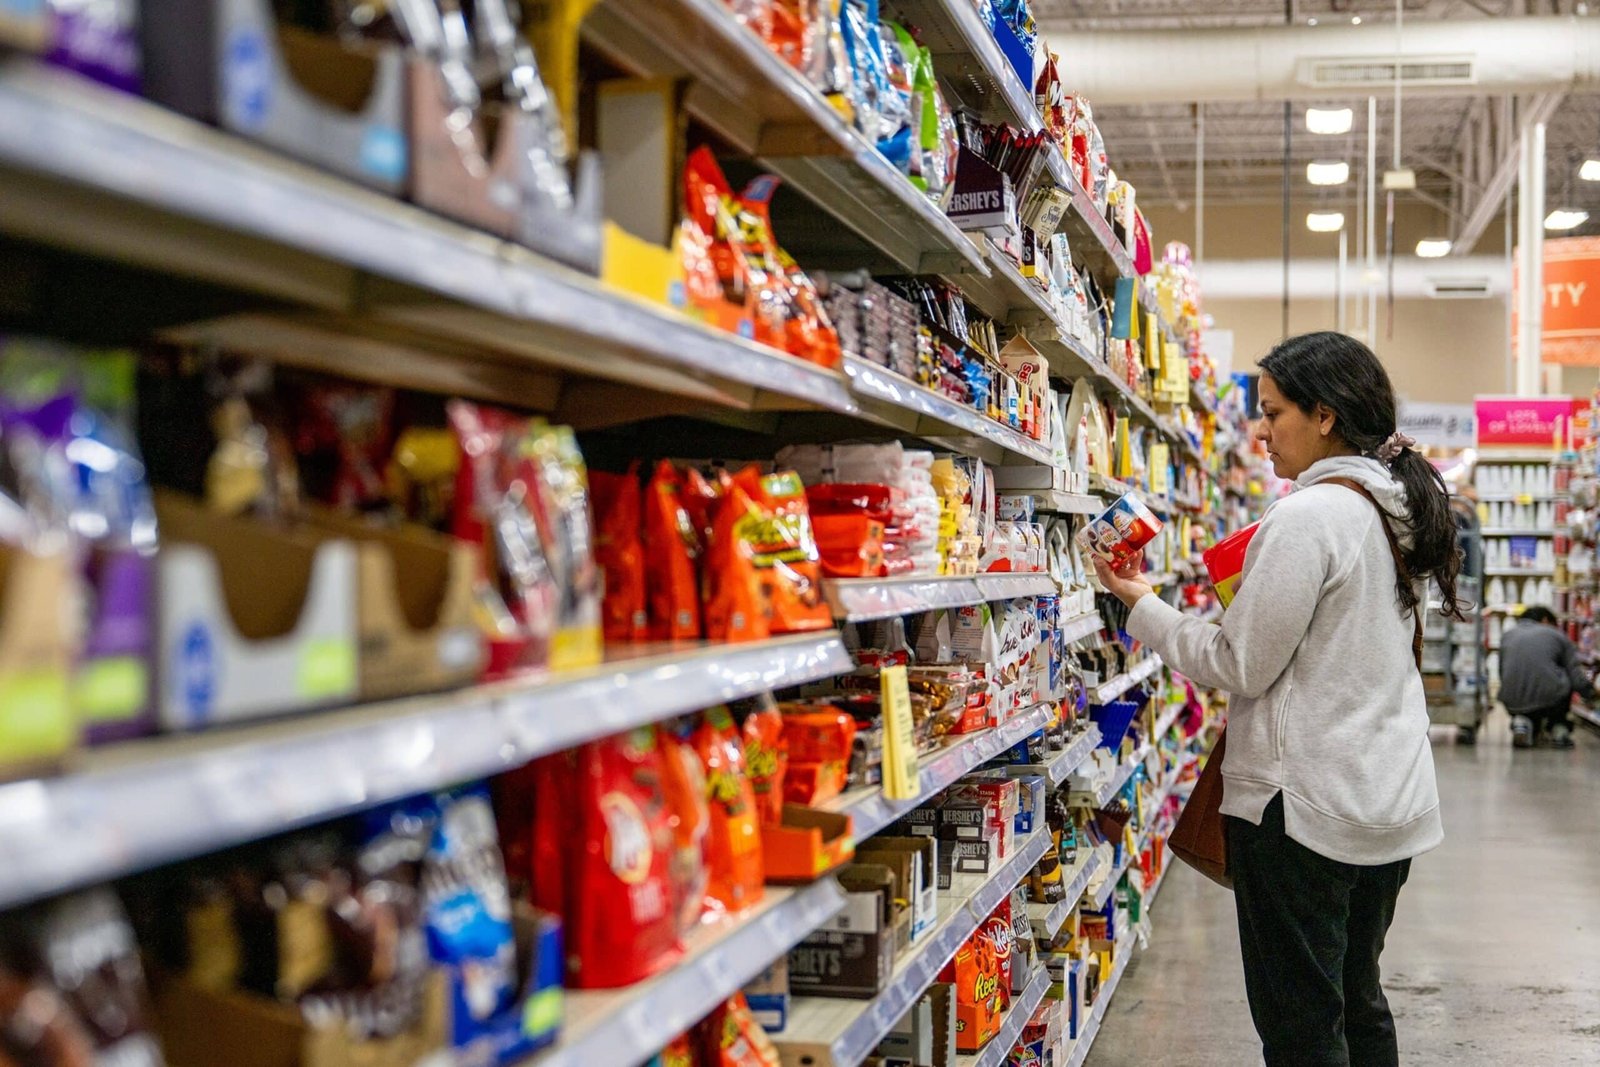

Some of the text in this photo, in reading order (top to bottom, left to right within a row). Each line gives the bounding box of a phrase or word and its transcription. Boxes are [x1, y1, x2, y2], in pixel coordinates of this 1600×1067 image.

[949, 189, 1000, 212] ERSHEY'S
[1548, 282, 1586, 308] TY
[943, 809, 981, 821] HERSHEY'S
[960, 842, 987, 856] SHEY'S
